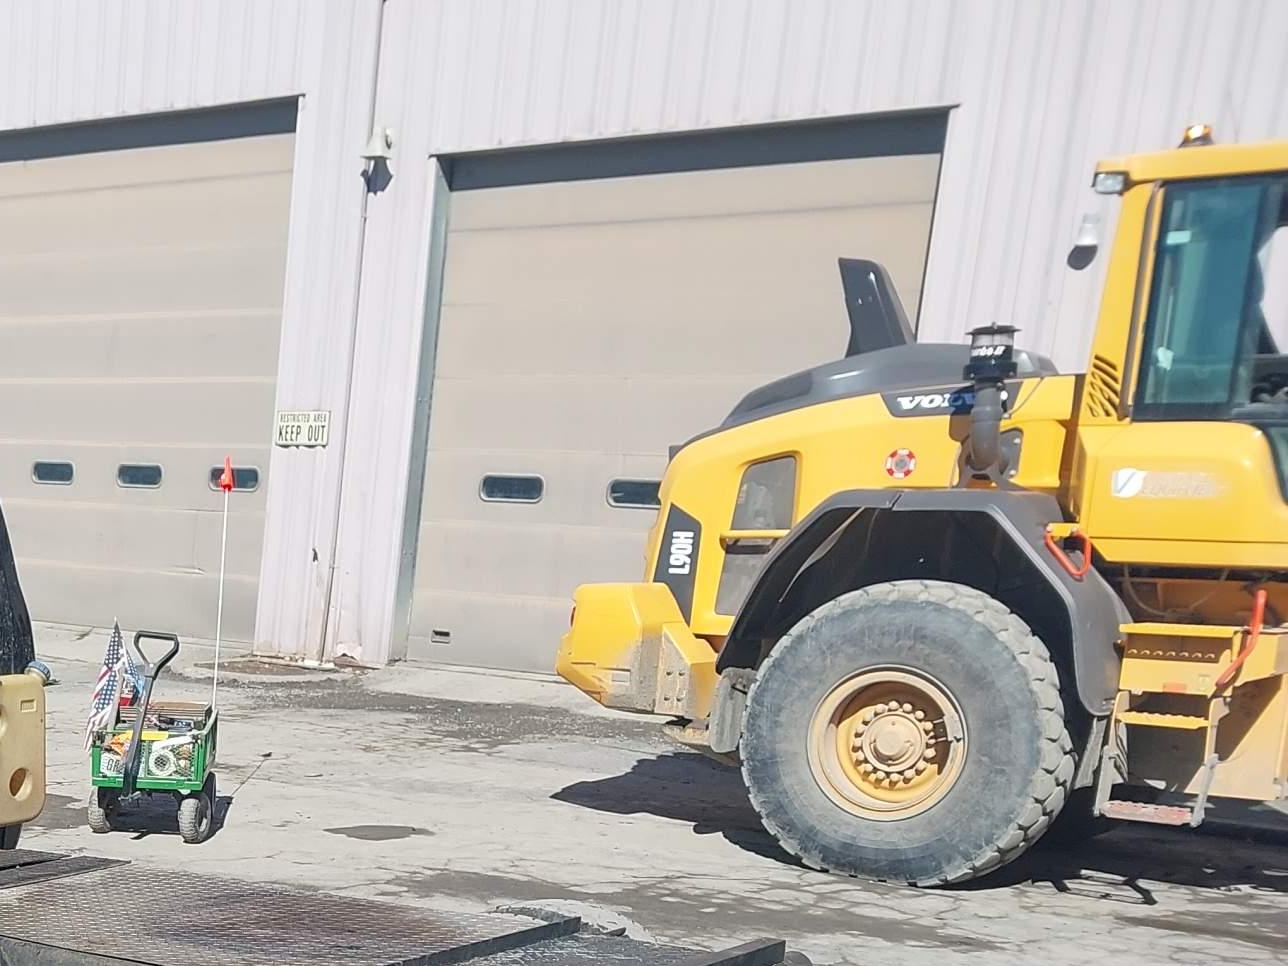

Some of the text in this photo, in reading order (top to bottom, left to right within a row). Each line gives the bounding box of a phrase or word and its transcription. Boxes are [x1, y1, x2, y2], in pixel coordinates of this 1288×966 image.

[313, 413, 327, 423] AREA
[278, 424, 326, 442] KEEP OUT
[668, 531, 694, 575] L90H
